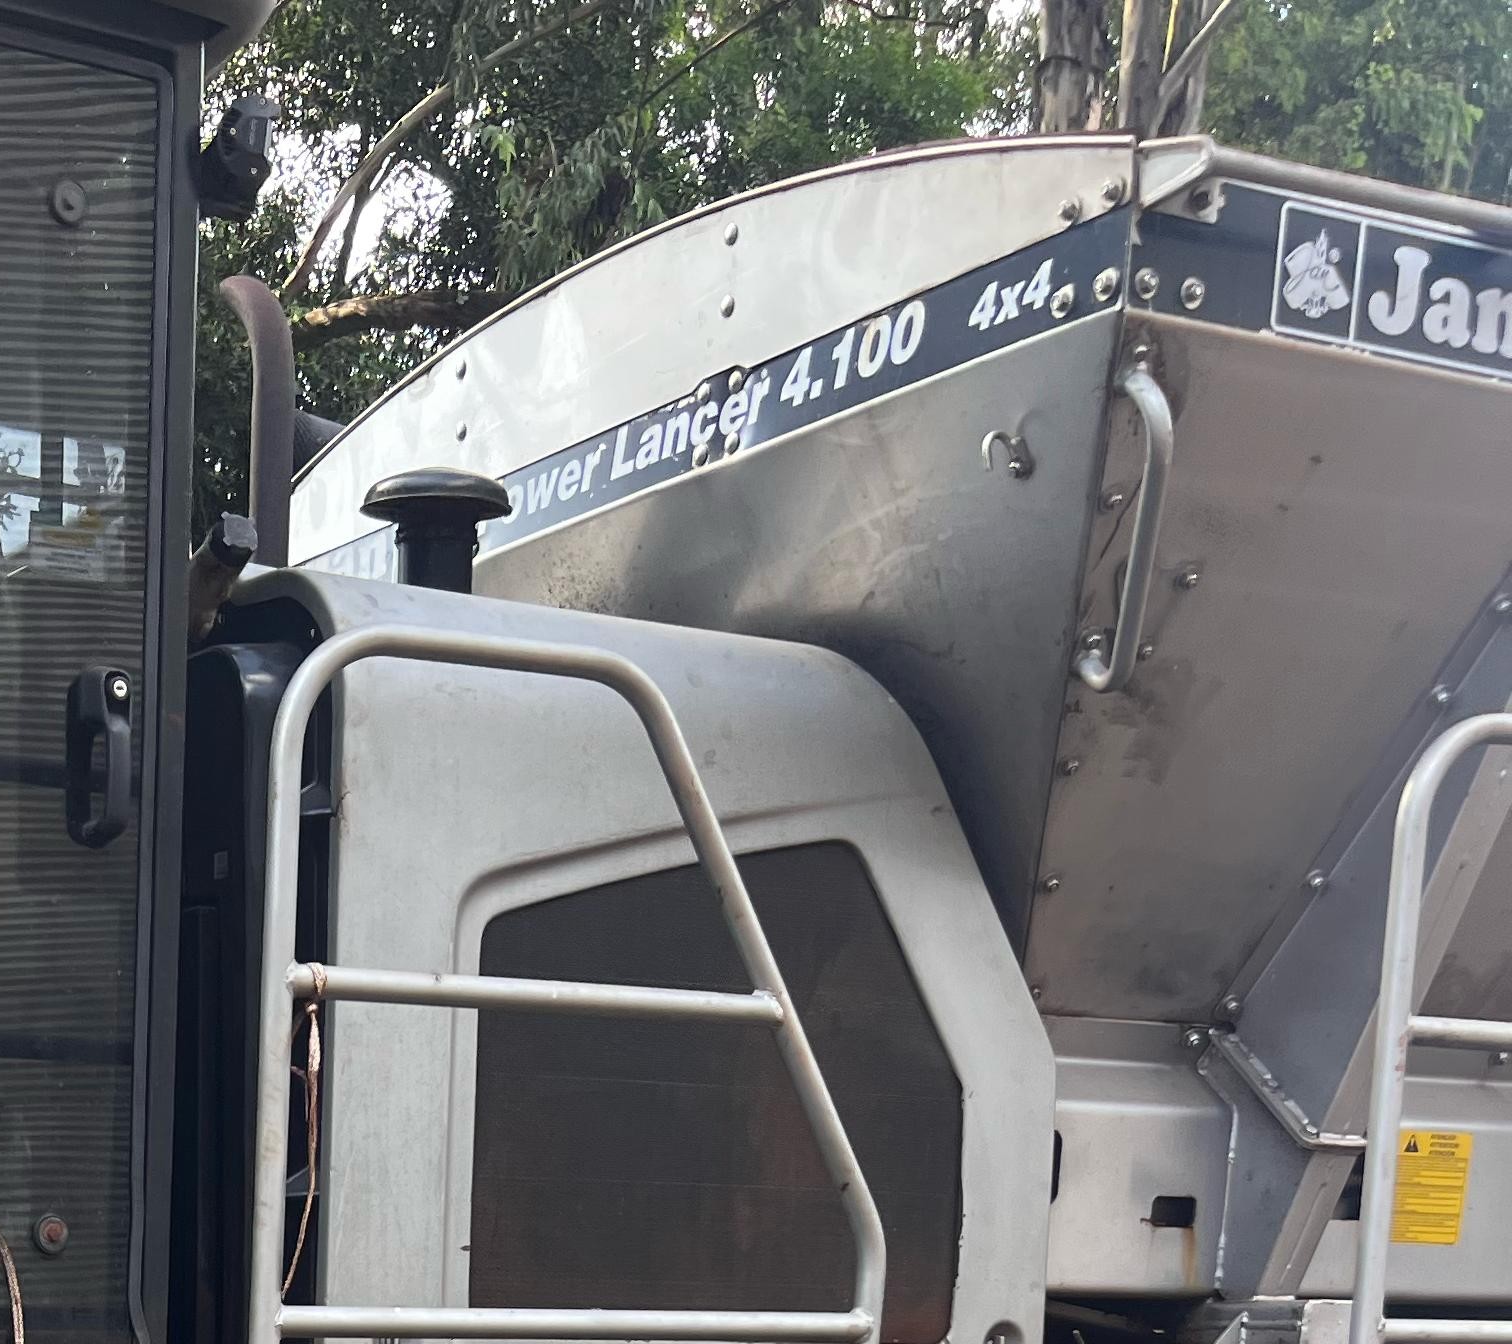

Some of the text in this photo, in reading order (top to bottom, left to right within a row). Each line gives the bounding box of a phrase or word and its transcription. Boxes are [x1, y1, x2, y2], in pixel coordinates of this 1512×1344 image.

[475, 443, 607, 541] ower
[609, 372, 771, 480] Lancer
[779, 299, 926, 408] 4.100
[968, 257, 1055, 331] 4x4
